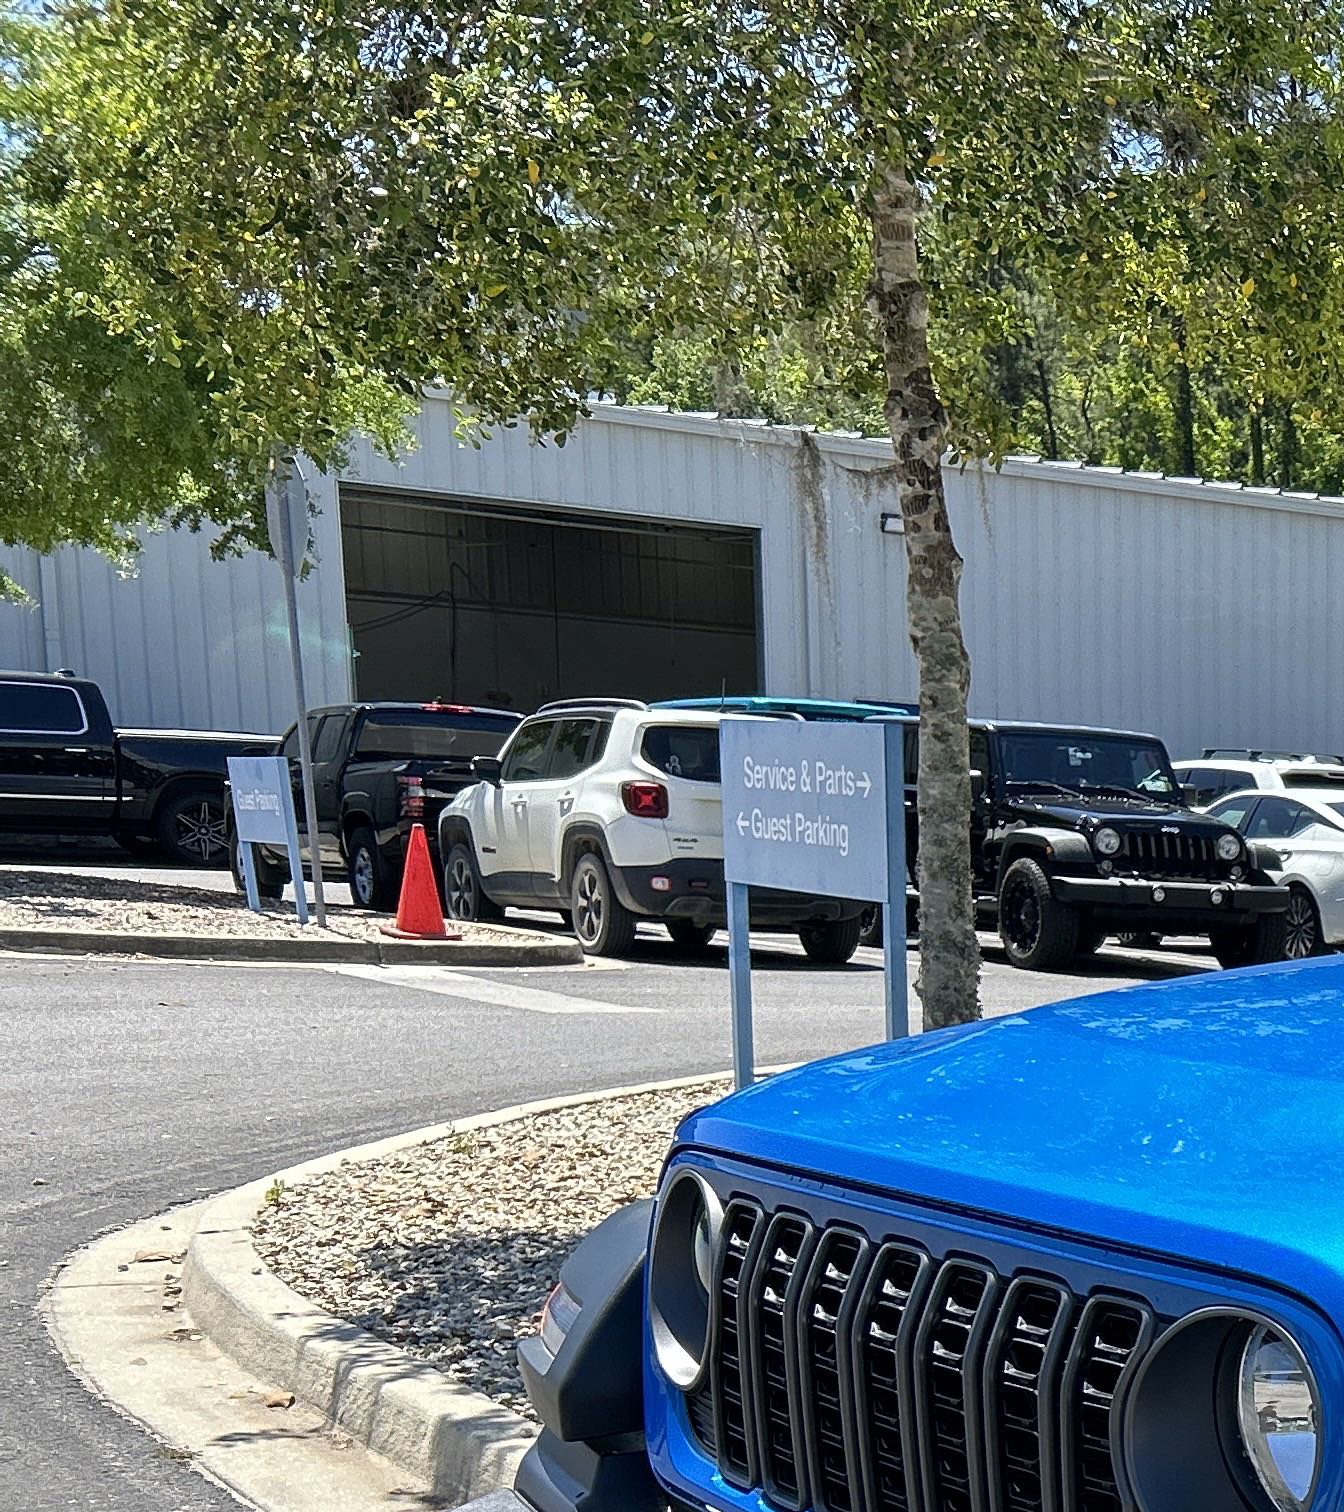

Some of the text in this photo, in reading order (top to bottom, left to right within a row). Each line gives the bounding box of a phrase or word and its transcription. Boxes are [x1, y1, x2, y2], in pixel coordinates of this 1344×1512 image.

[743, 755, 856, 797] Service & Parts
[751, 808, 849, 857] Guest Parking
